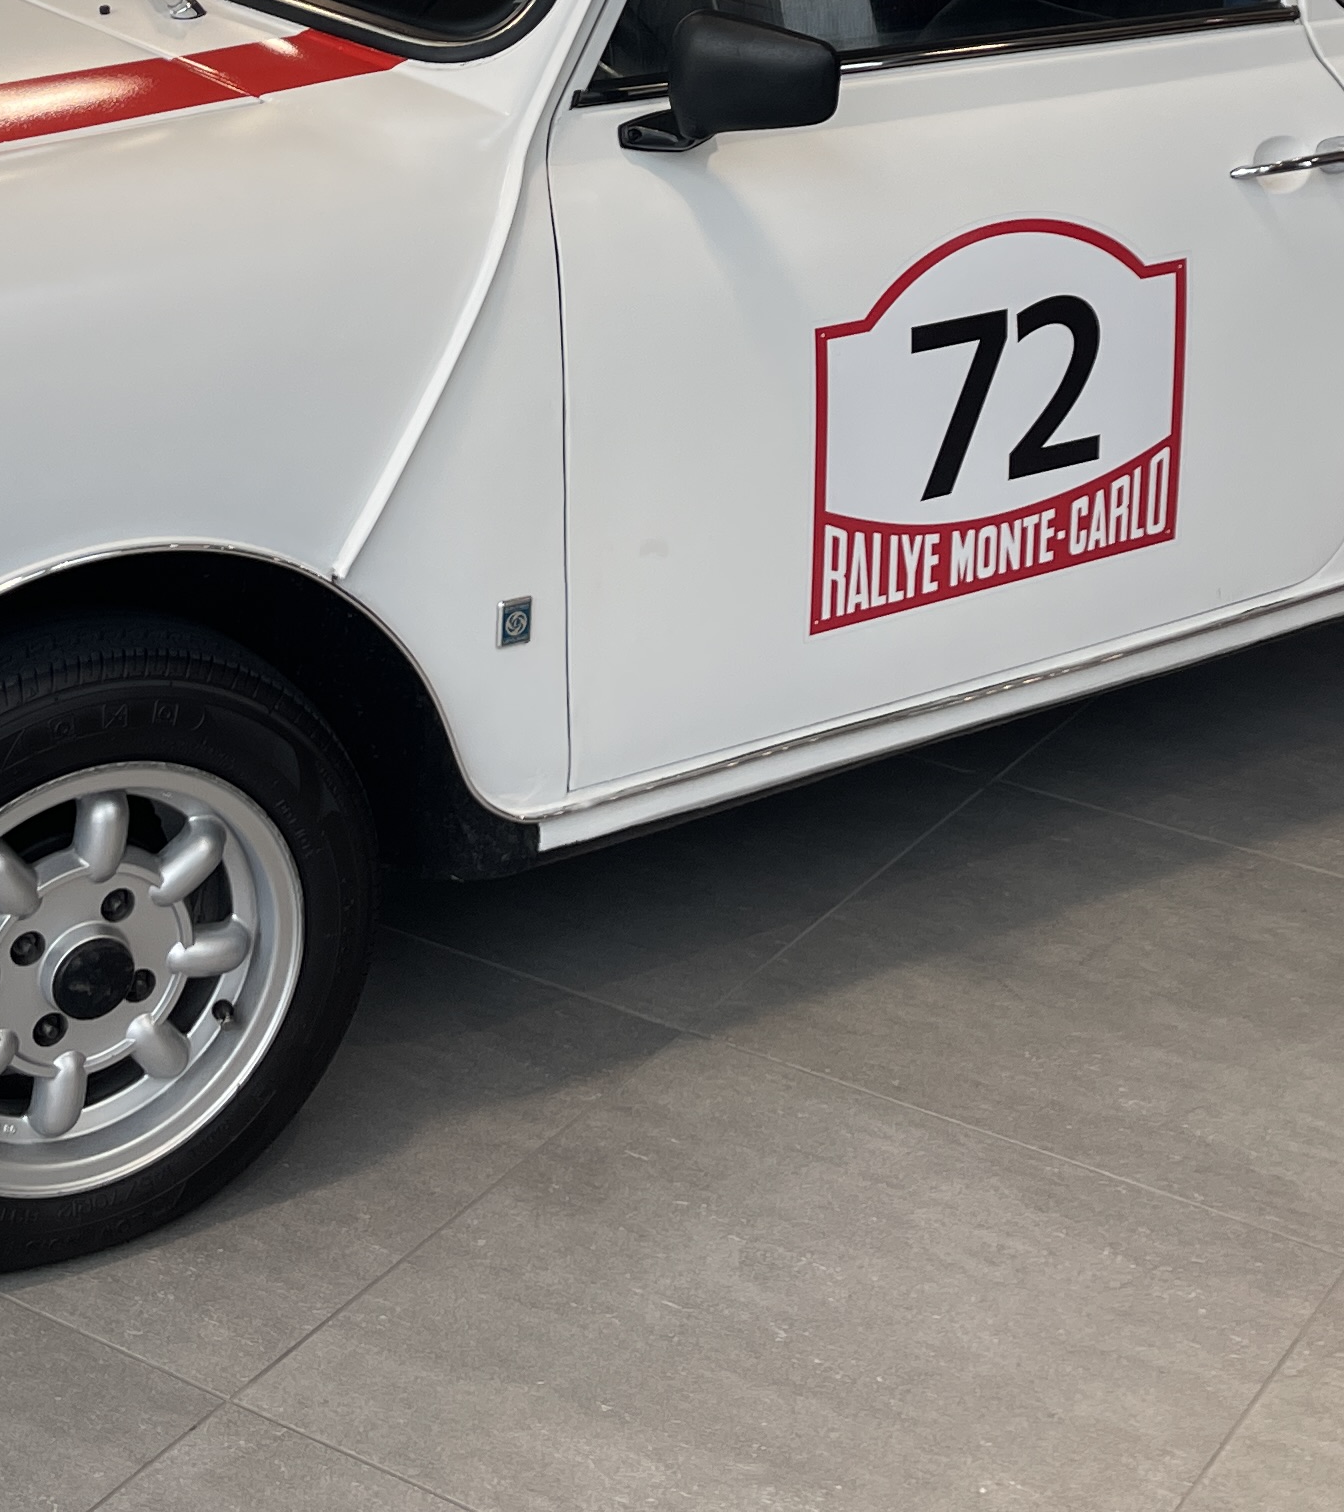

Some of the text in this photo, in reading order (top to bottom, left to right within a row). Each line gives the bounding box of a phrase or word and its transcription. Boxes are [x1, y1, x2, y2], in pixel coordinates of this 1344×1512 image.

[910, 294, 1101, 502] 72
[820, 445, 1172, 621] RALLYE MONTE-CARLO
